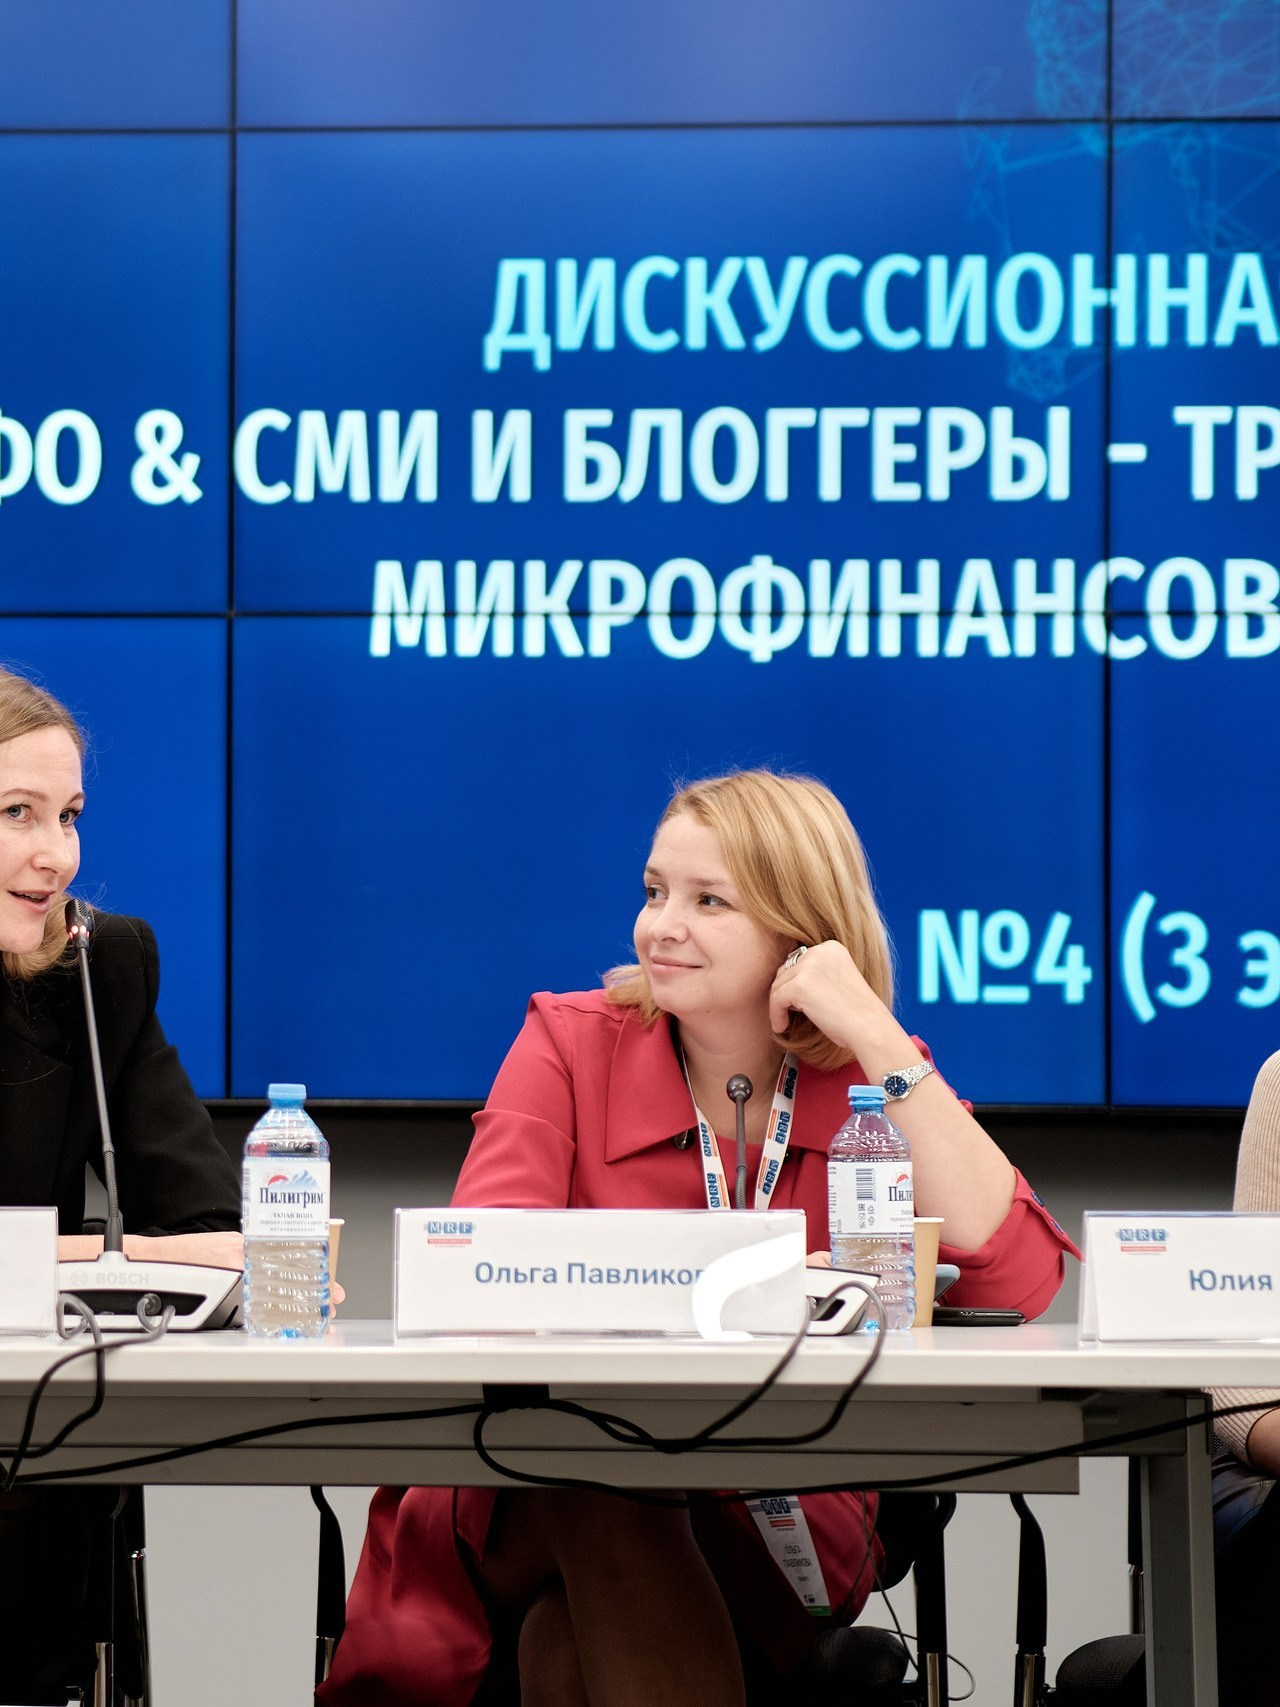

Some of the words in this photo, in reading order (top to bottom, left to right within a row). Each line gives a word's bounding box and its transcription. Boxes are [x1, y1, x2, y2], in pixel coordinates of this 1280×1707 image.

[483, 252, 1280, 371] ДИСКУССИОННА
[130, 409, 203, 505] &
[233, 408, 439, 504] СМИ
[472, 409, 533, 503] И
[563, 406, 1071, 504] БЛОГГЕРЫ
[1173, 405, 1280, 500] ТР
[369, 555, 1280, 663] МИКРОФИНАНСОВ
[920, 909, 1093, 1004] №4
[1122, 891, 1211, 1022] (3
[1238, 930, 1280, 1007] э
[260, 1188, 323, 1208] Пилигрим
[428, 1221, 472, 1233] MRF
[1120, 1229, 1166, 1241] MRF
[96, 1272, 150, 1285] BOSCH
[475, 1262, 557, 1284] Ольга
[1189, 1269, 1272, 1291] Юлия
